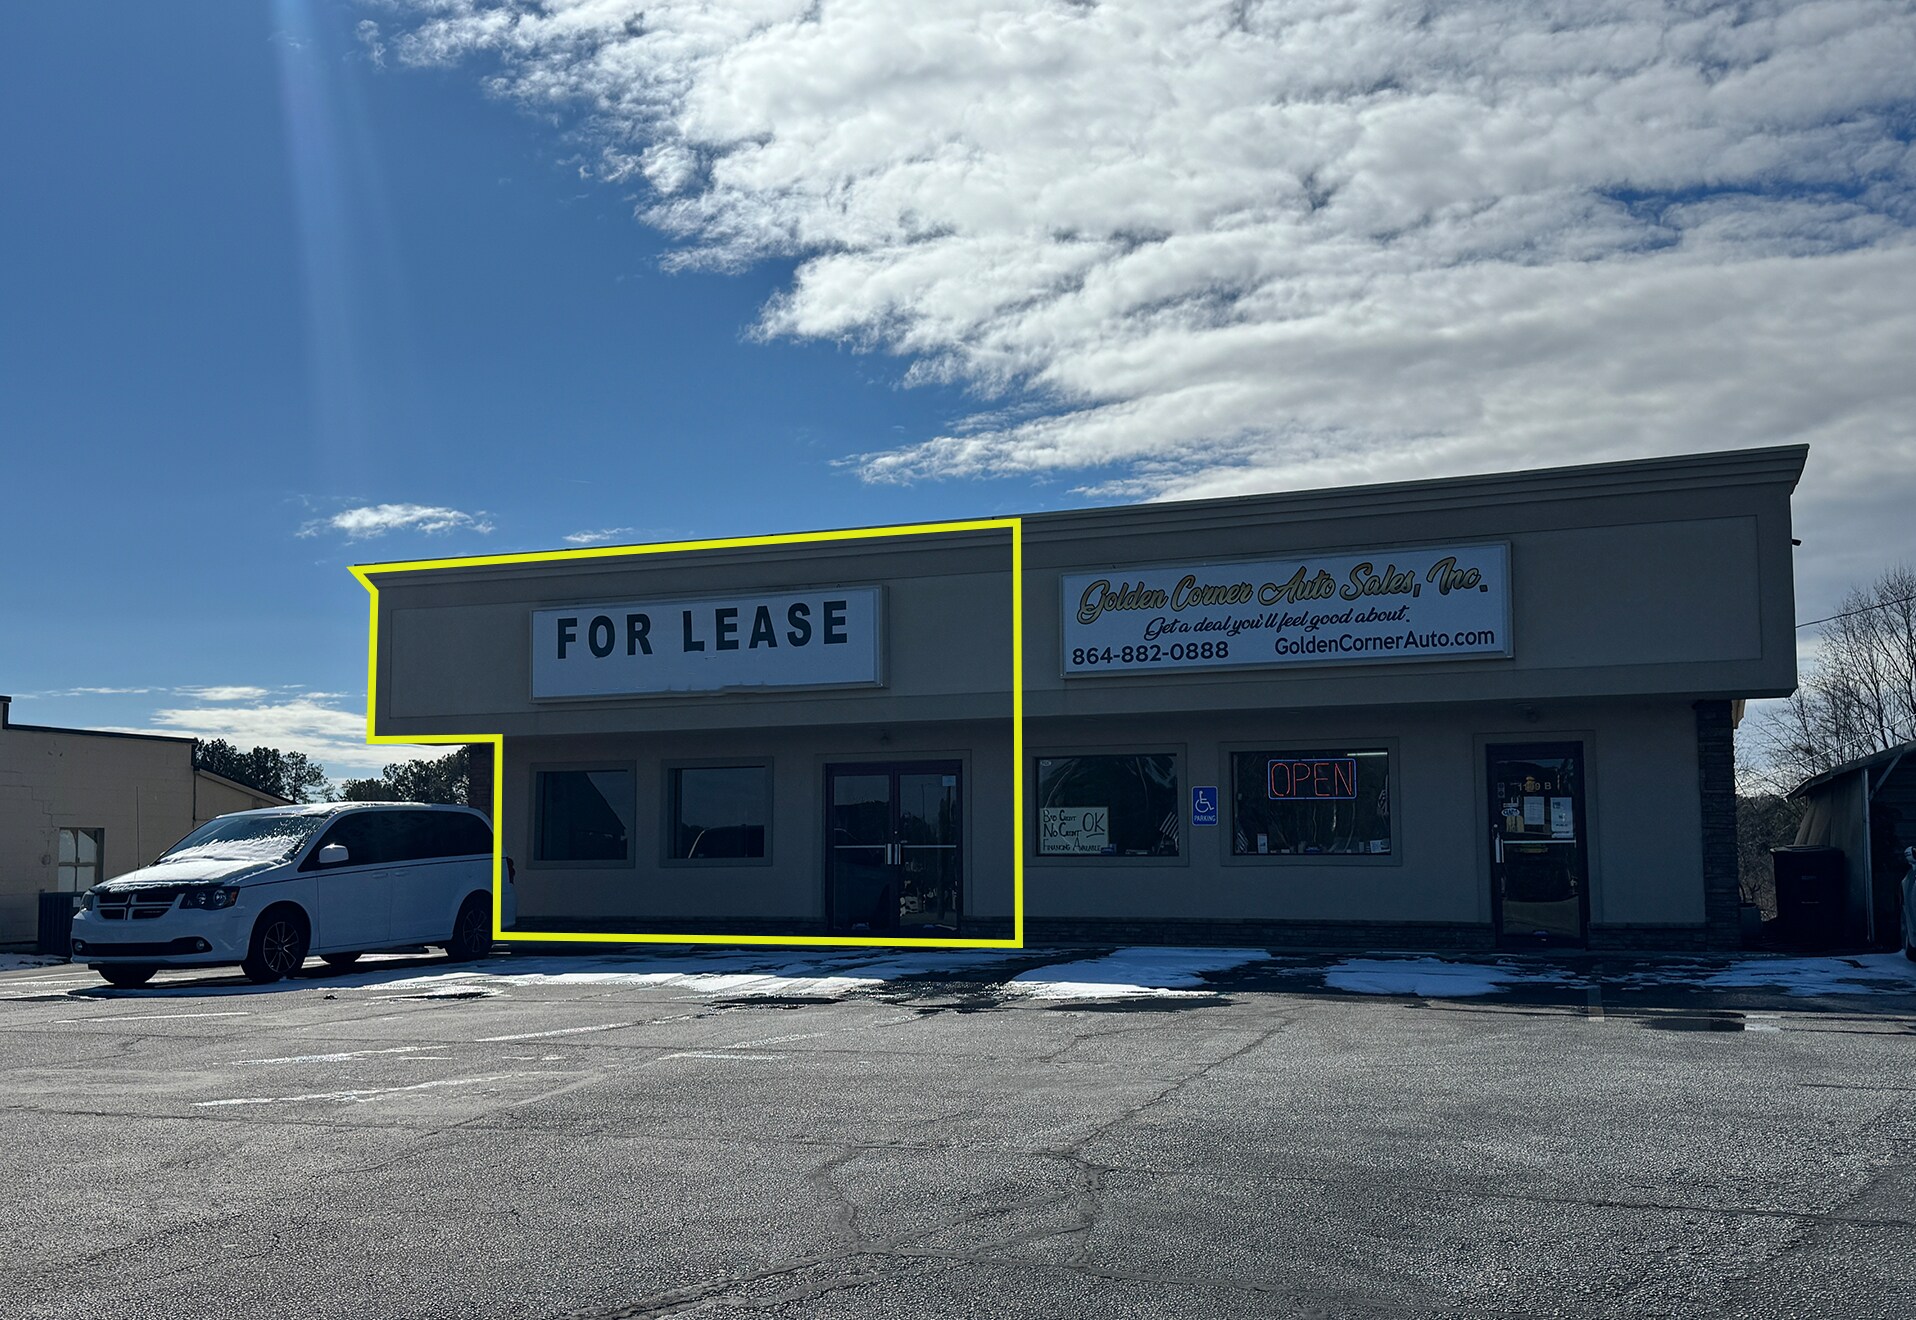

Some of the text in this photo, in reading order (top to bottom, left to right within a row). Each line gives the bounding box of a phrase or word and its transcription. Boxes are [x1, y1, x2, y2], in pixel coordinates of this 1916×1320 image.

[1077, 556, 1488, 625] Golden Corner Auto Sales, Inc.
[557, 600, 848, 659] FOR LEASE
[1144, 616, 1180, 641] Get
[1179, 622, 1191, 633] a
[1194, 615, 1231, 633] deal
[1276, 611, 1308, 633] feel
[1305, 608, 1354, 633] good
[1355, 604, 1410, 624] about.
[1072, 641, 1229, 665] 864-882-0888
[1275, 630, 1495, 655] GoldenCornerAuto.com
[1271, 762, 1353, 797] OPEN
[1082, 812, 1105, 832] OK
